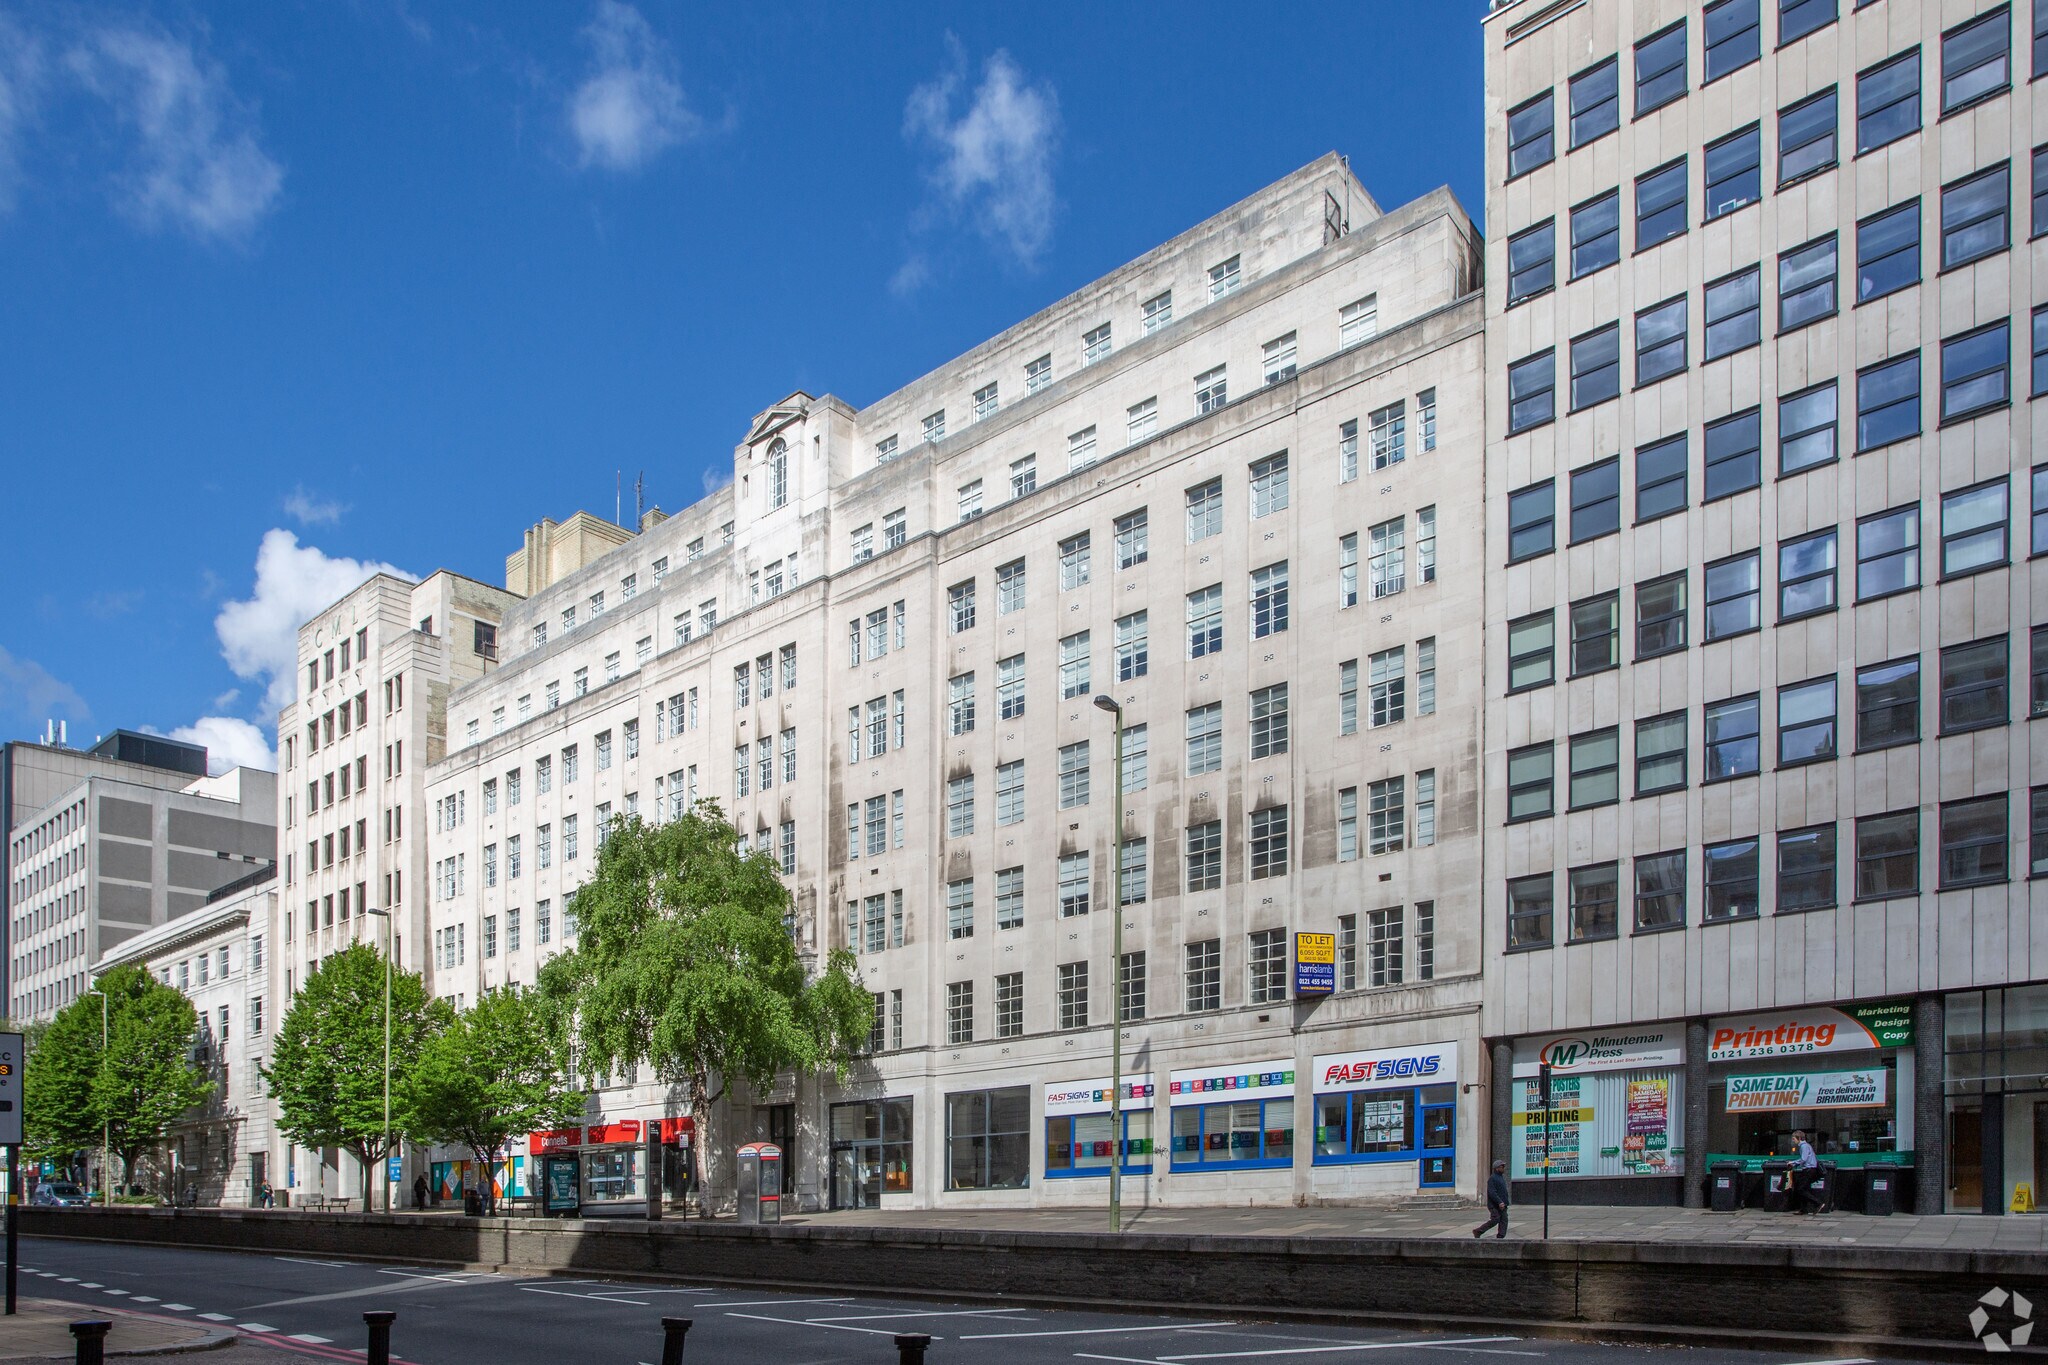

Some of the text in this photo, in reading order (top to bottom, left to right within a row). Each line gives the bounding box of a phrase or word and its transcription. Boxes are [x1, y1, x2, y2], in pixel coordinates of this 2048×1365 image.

[1300, 934, 1331, 945] TO LET
[1298, 963, 1333, 974] harrislamb
[1320, 978, 1333, 986] 9455
[1857, 1005, 1910, 1017] Marketing
[1873, 1017, 1910, 1028] Design
[1711, 1021, 1837, 1051] Printing
[1882, 1030, 1910, 1040] Copy
[1591, 1033, 1664, 1049] Minuteman
[1589, 1047, 1623, 1059] Press
[1711, 1043, 1814, 1059] 0121 236 0378
[1324, 1054, 1441, 1085] FASTSIGNS
[1552, 1077, 1580, 1092] POSTERS
[1638, 1083, 1658, 1091] PRINT
[1731, 1076, 1805, 1093] SAME DAY
[1817, 1084, 1876, 1096] free delivery in
[1048, 1091, 1090, 1101] FASTSIGNS
[1727, 1090, 1801, 1108] PRINTING
[1815, 1093, 1875, 1104] BIRMINGHAM
[1526, 1125, 1543, 1133] DESIGN
[1542, 1123, 1565, 1133] SRVICES
[541, 1135, 568, 1147] Connells
[1526, 1130, 1580, 1141] COMPLMENT SLIPS
[1552, 1138, 1580, 1147] BINDING
[1526, 1145, 1553, 1154] NOTEPAS
[1526, 1153, 1546, 1163] MENU
[1526, 1165, 1579, 1175] MAIL MRGE LABELS
